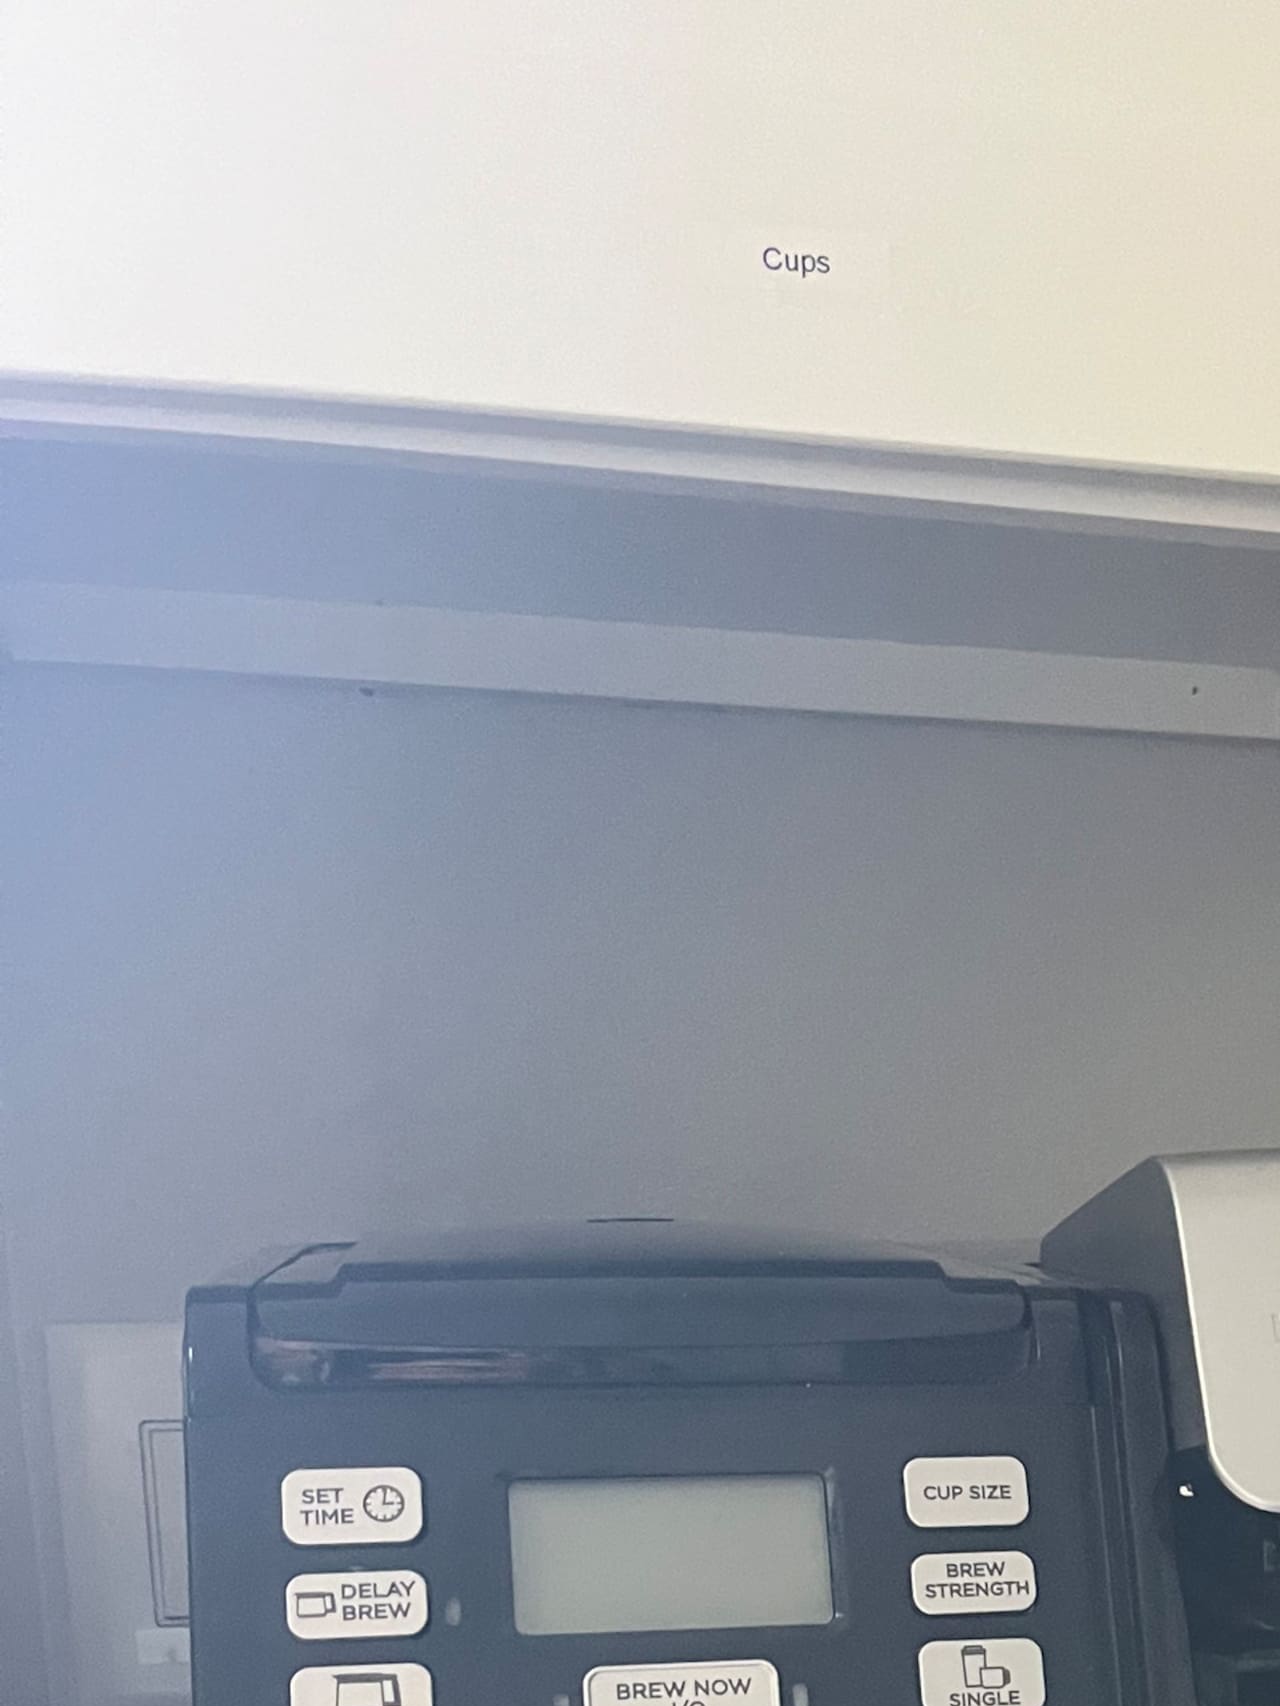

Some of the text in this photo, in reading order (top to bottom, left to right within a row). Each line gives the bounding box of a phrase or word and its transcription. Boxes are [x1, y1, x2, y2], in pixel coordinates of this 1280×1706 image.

[763, 247, 830, 278] Cups
[302, 1488, 344, 1504] SET
[923, 1485, 1012, 1500] CUP SIZE
[300, 1508, 354, 1526] TIME
[946, 1561, 1005, 1578] BREW
[341, 1580, 416, 1599] DELAY
[925, 1580, 1030, 1599] STRENGTH
[342, 1602, 411, 1621] BREW
[616, 1677, 751, 1700] BREW NOW
